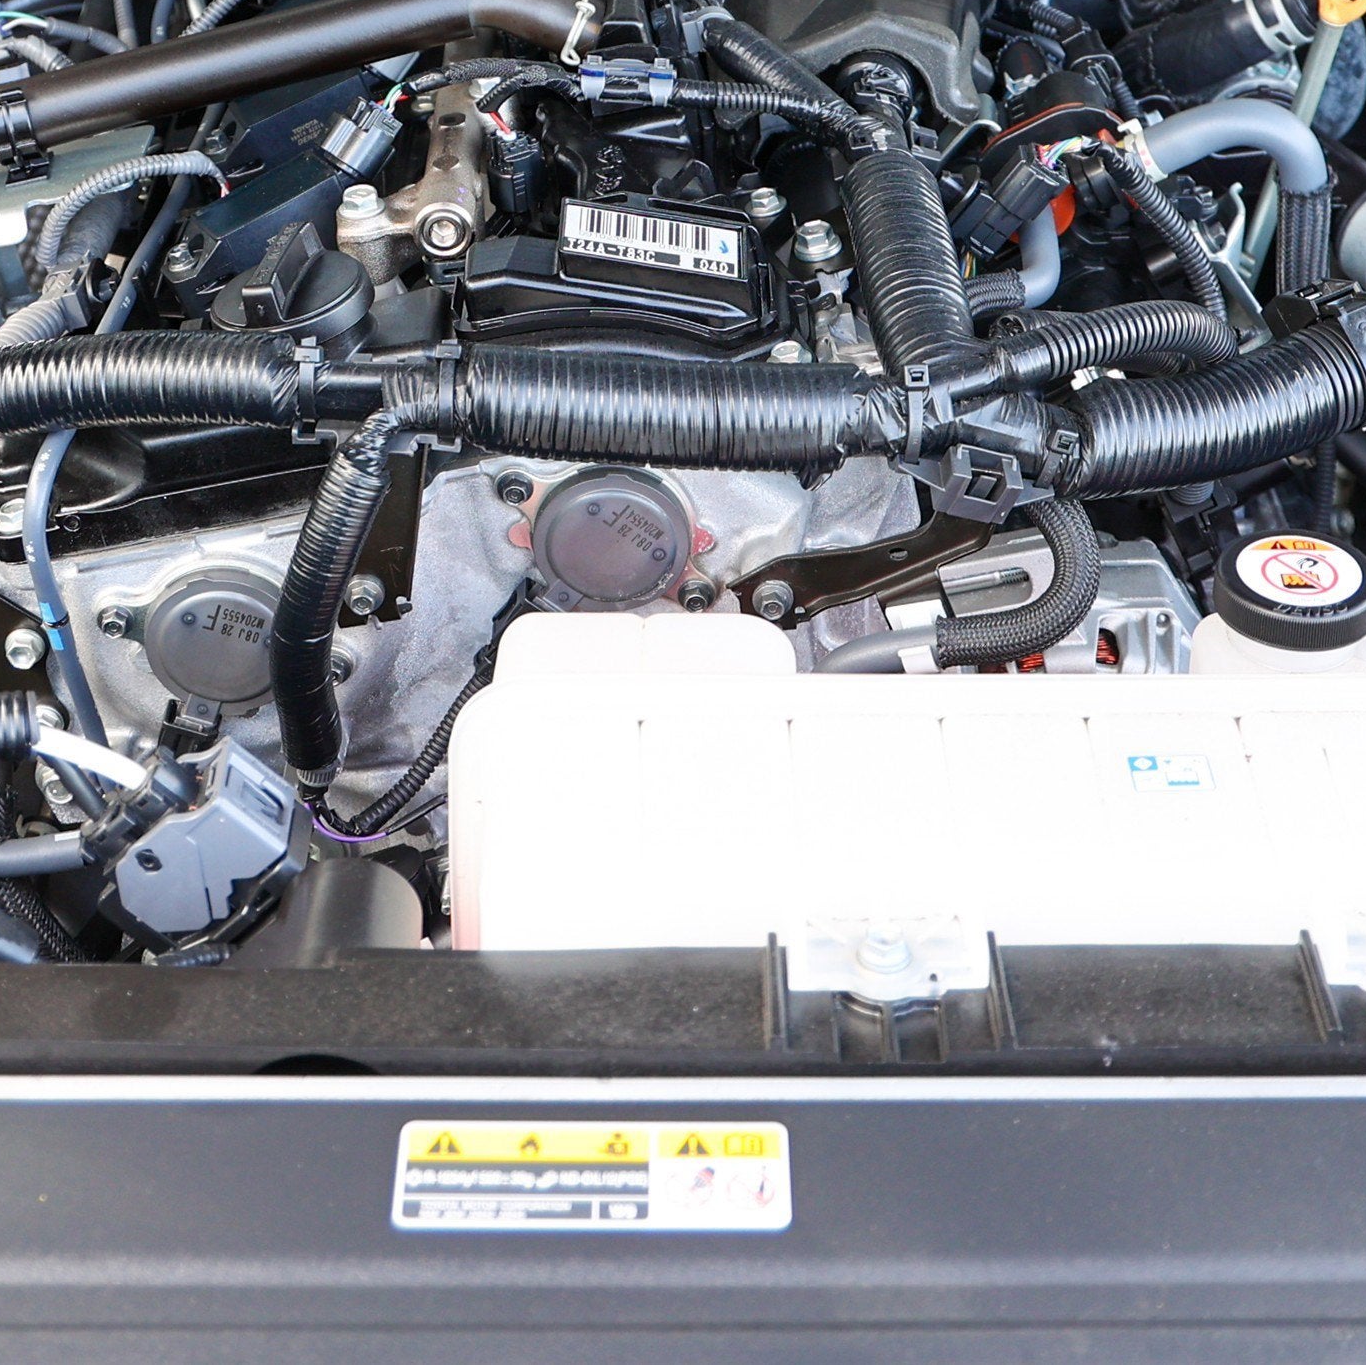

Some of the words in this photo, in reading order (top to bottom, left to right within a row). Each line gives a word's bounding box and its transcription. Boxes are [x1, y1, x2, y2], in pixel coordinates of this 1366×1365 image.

[567, 238, 656, 261] T24A-T83C
[602, 504, 631, 528] F
[202, 604, 222, 631] F
[221, 608, 266, 629] M204555
[1271, 602, 1348, 619] DENSO
[221, 623, 233, 636] 28
[237, 629, 260, 644] 08J
